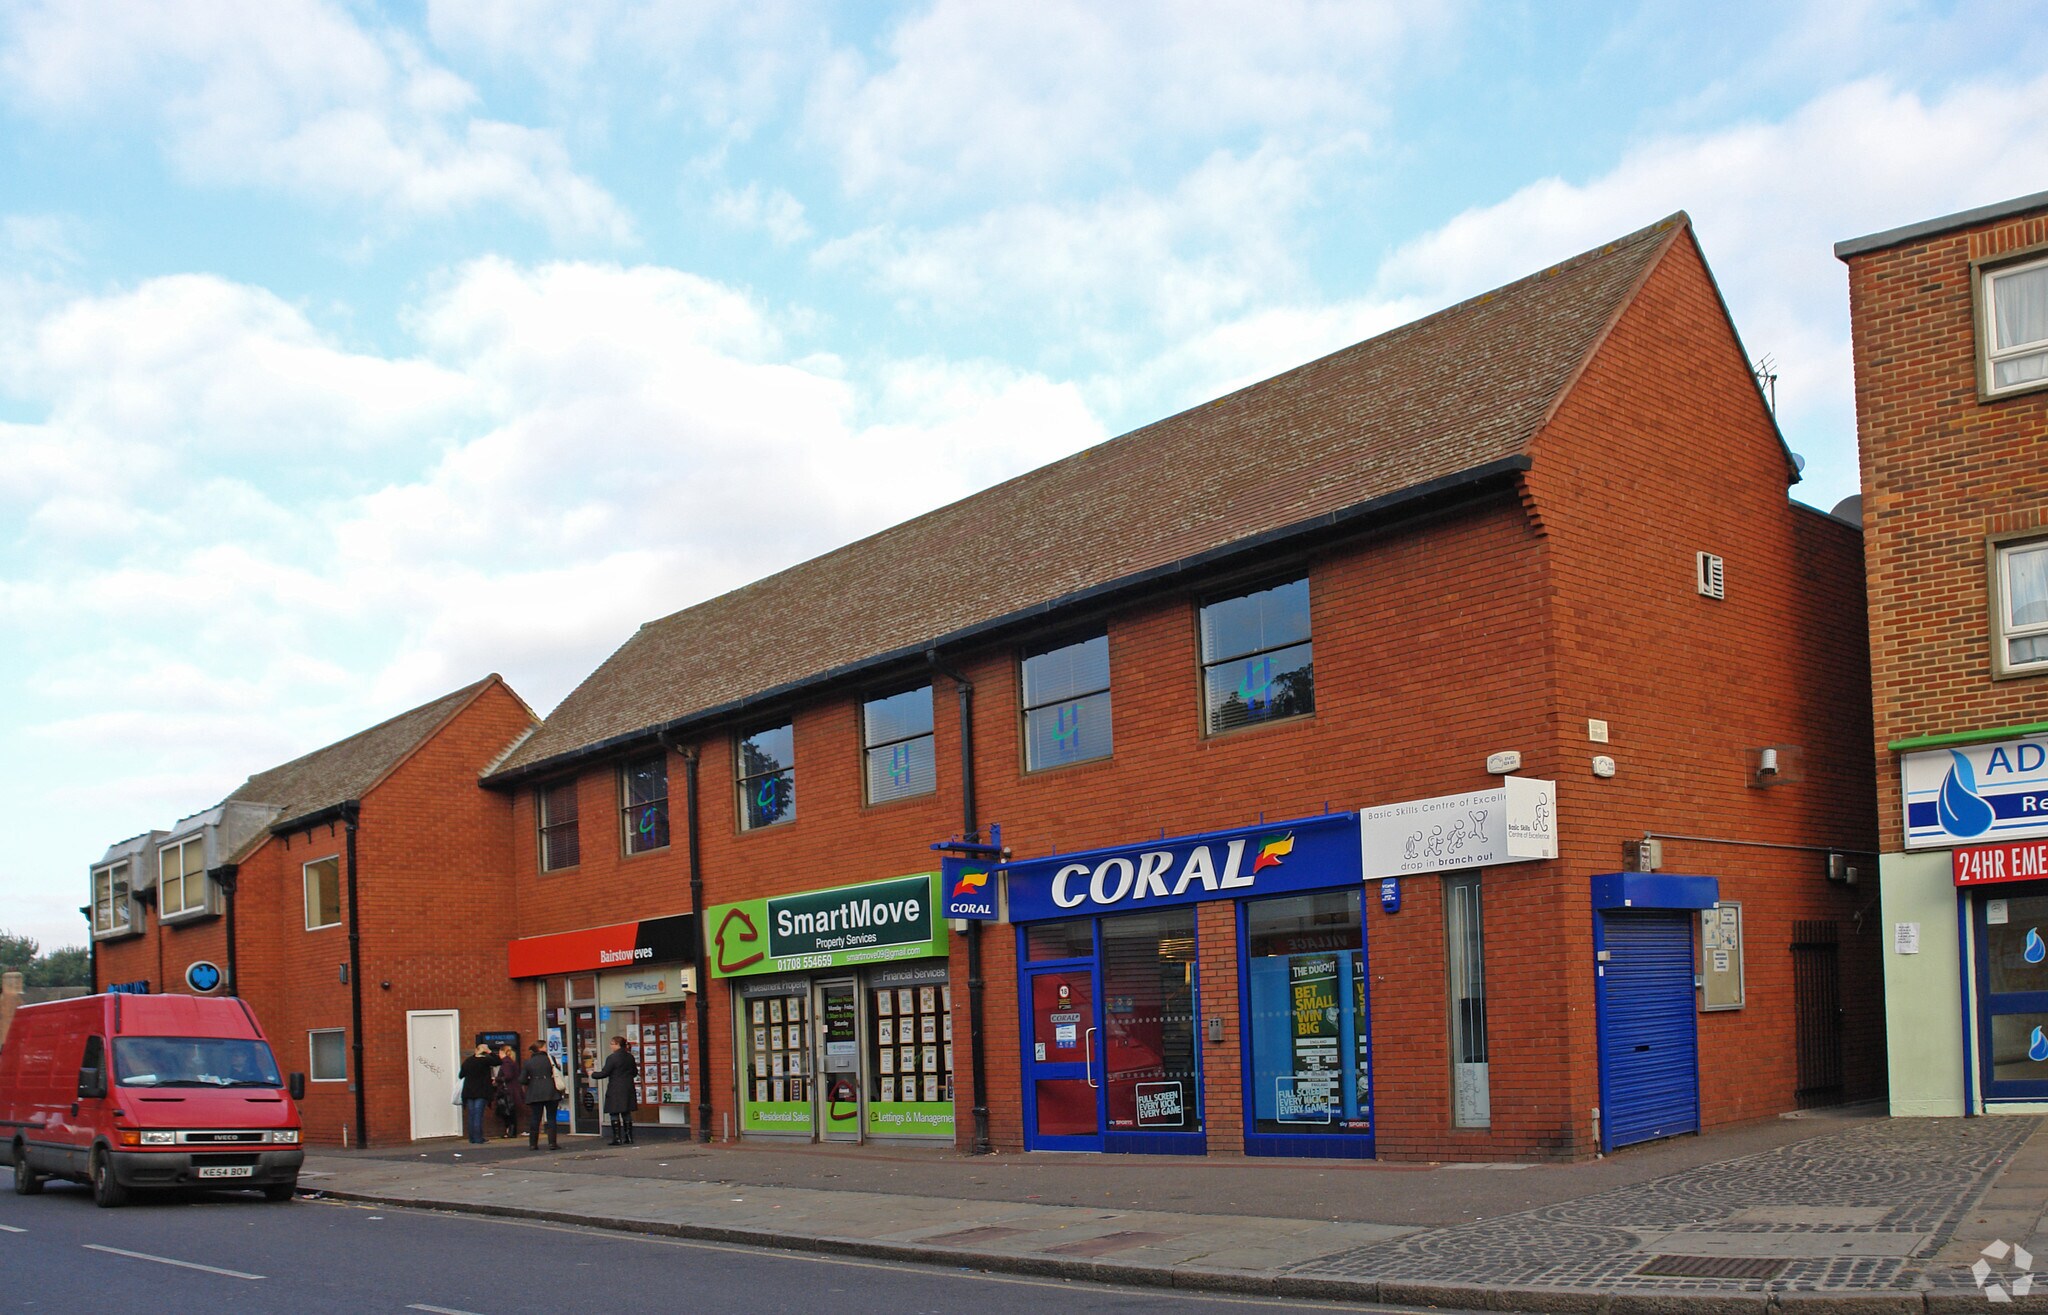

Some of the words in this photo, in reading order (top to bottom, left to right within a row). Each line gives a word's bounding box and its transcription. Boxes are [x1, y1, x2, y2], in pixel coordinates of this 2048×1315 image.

[1986, 743, 2048, 776] AD
[1368, 810, 1392, 820] Basic
[1396, 806, 1418, 816] Skills
[1422, 802, 1455, 812] Centre
[1459, 798, 1469, 807] of
[1401, 860, 1423, 873] drop
[1426, 859, 1435, 867] in
[1438, 856, 1473, 866] branch
[1477, 852, 1493, 861] out
[1959, 850, 2006, 881] 24HR
[1051, 839, 1255, 908] CORAL
[950, 902, 991, 914] CORAL
[777, 898, 920, 937] SmartMove
[816, 935, 845, 949] Property
[846, 932, 877, 945] Services
[600, 949, 634, 963] Bairstow
[634, 947, 653, 959] eves
[846, 947, 921, 962] smartmove09@gmail.com
[777, 959, 801, 971] 01708
[803, 954, 832, 968] 554659
[882, 969, 913, 981] Financial
[914, 968, 946, 979] Services
[1292, 965, 1308, 978] THE
[750, 981, 782, 992] Investment
[1294, 985, 1318, 999] BET
[1295, 995, 1335, 1011] SMALL
[1051, 1014, 1076, 1022] CORAL
[1296, 1009, 1322, 1023] WIN
[1297, 1021, 1320, 1035] BIG
[1138, 1096, 1153, 1104] FULL
[1154, 1091, 1178, 1102] SCREEN
[1279, 1090, 1296, 1099] FULL
[1139, 1102, 1159, 1112] EVERY
[1160, 1099, 1176, 1108] KICK
[1280, 1097, 1302, 1107] EVERY
[1280, 1105, 1303, 1115] EVERY
[1304, 1102, 1328, 1113] GAME
[760, 1111, 792, 1121] Residential
[793, 1111, 810, 1122] Sales
[878, 1111, 904, 1126] Lettings
[906, 1111, 912, 1122] &
[1140, 1109, 1161, 1119] EVERY
[1161, 1106, 1181, 1116] GAME
[202, 1168, 227, 1176] KE54
